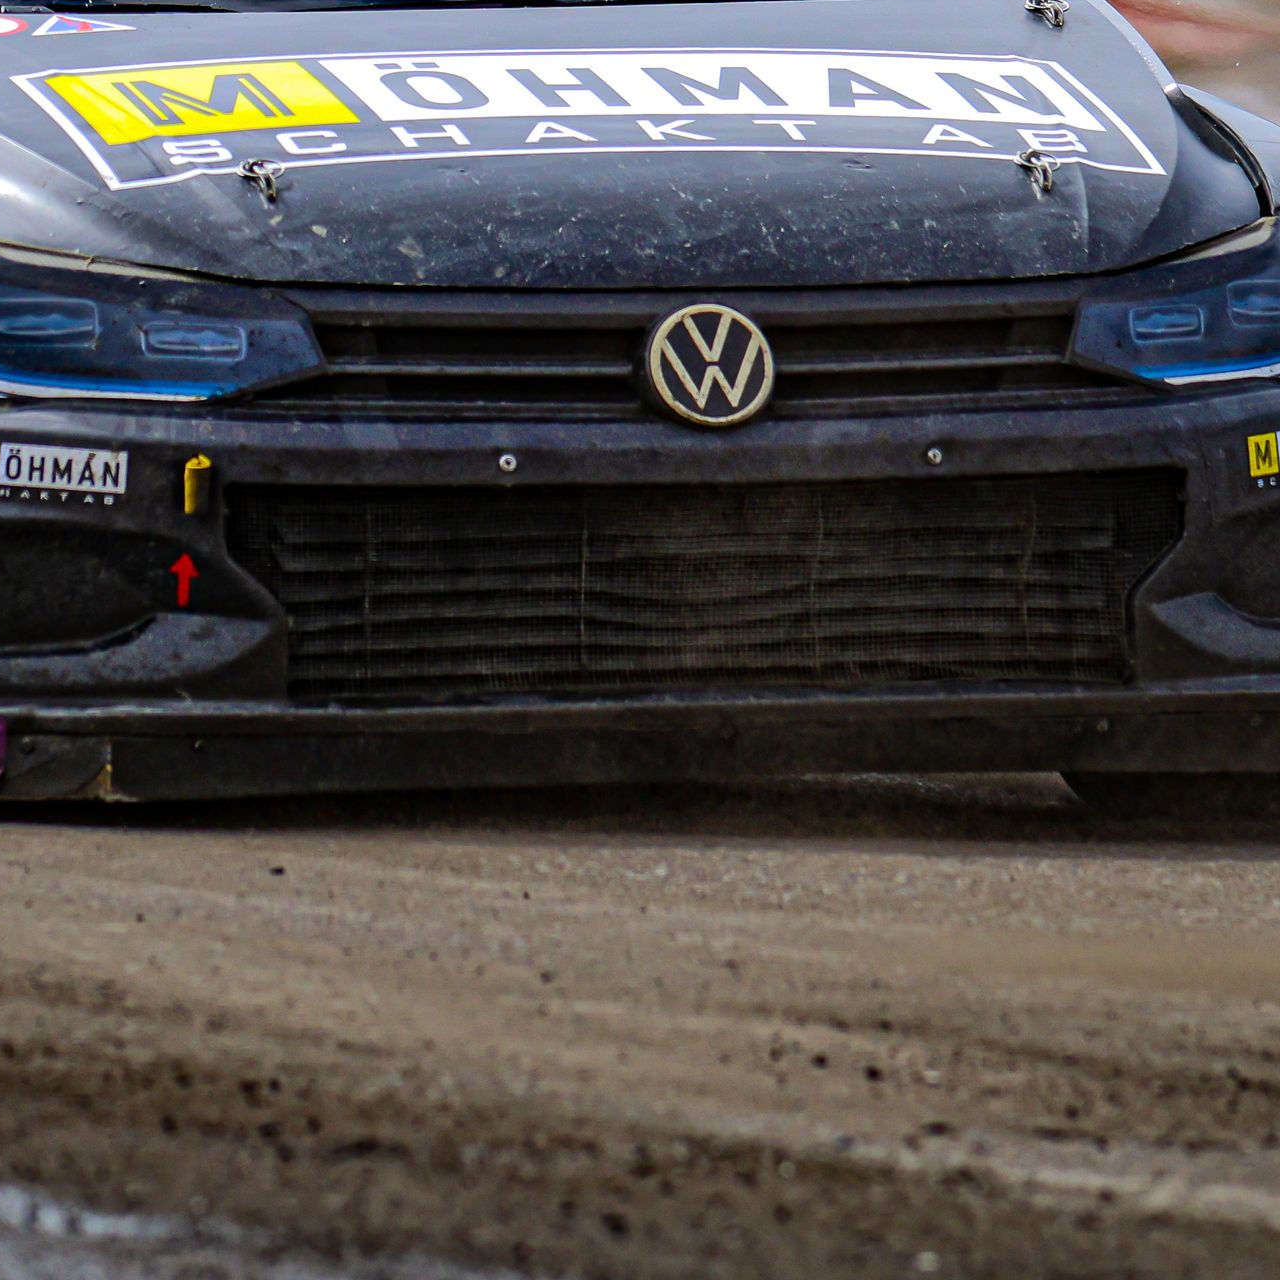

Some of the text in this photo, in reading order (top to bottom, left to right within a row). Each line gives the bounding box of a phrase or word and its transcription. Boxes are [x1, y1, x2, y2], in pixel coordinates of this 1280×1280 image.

[110, 62, 1068, 126] M ÖHMAN
[161, 119, 1089, 166] SCHAKT AB
[5, 448, 120, 488] ÖHMAN
[1253, 439, 1273, 471] M
[83, 493, 115, 506] AB
